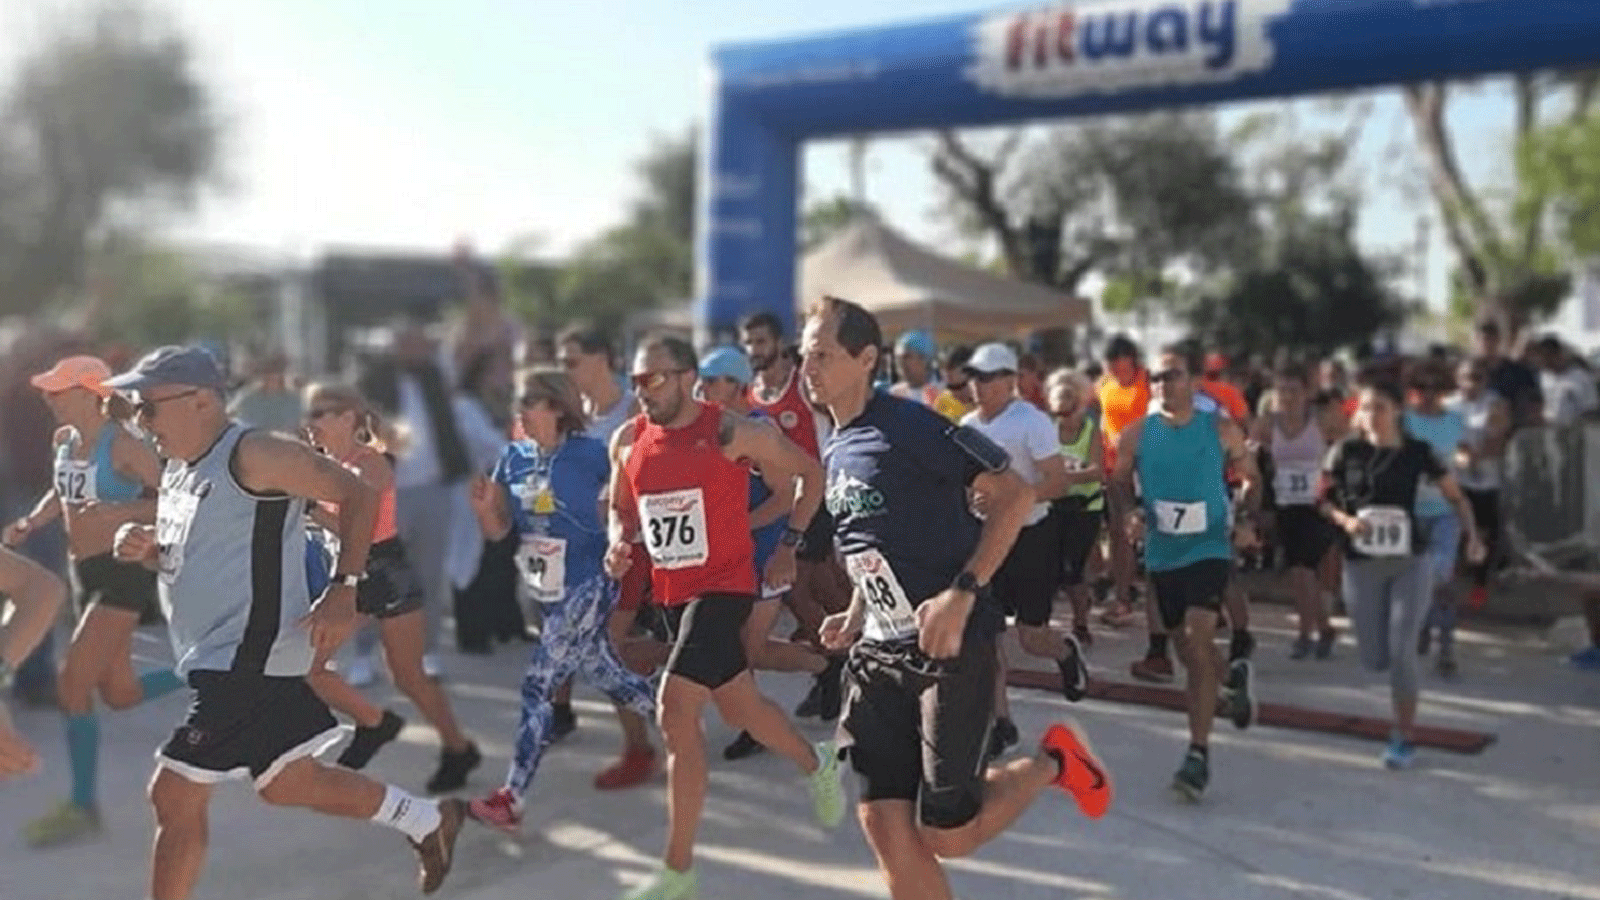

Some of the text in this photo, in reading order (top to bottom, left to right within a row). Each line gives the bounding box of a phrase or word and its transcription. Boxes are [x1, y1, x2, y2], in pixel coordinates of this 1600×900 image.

[1004, 0, 1236, 71] fitway
[57, 472, 86, 499] 512
[648, 514, 695, 548] 376
[1173, 507, 1186, 530] 7
[866, 575, 897, 612] 48
